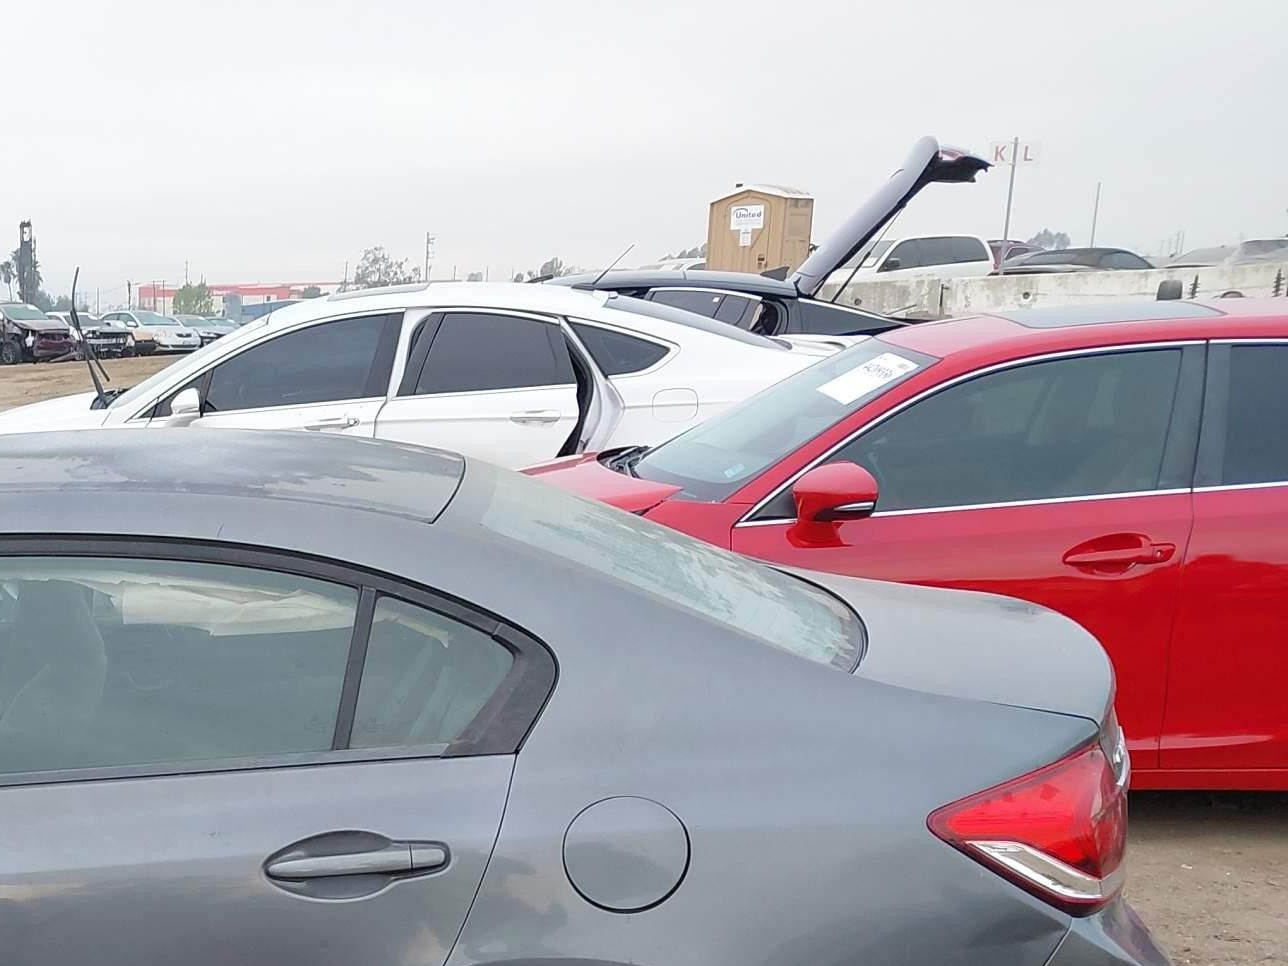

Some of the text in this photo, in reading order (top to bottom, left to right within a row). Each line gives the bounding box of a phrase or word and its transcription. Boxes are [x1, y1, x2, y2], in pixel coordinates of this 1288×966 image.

[993, 145, 1033, 162] K L
[735, 210, 762, 220] United
